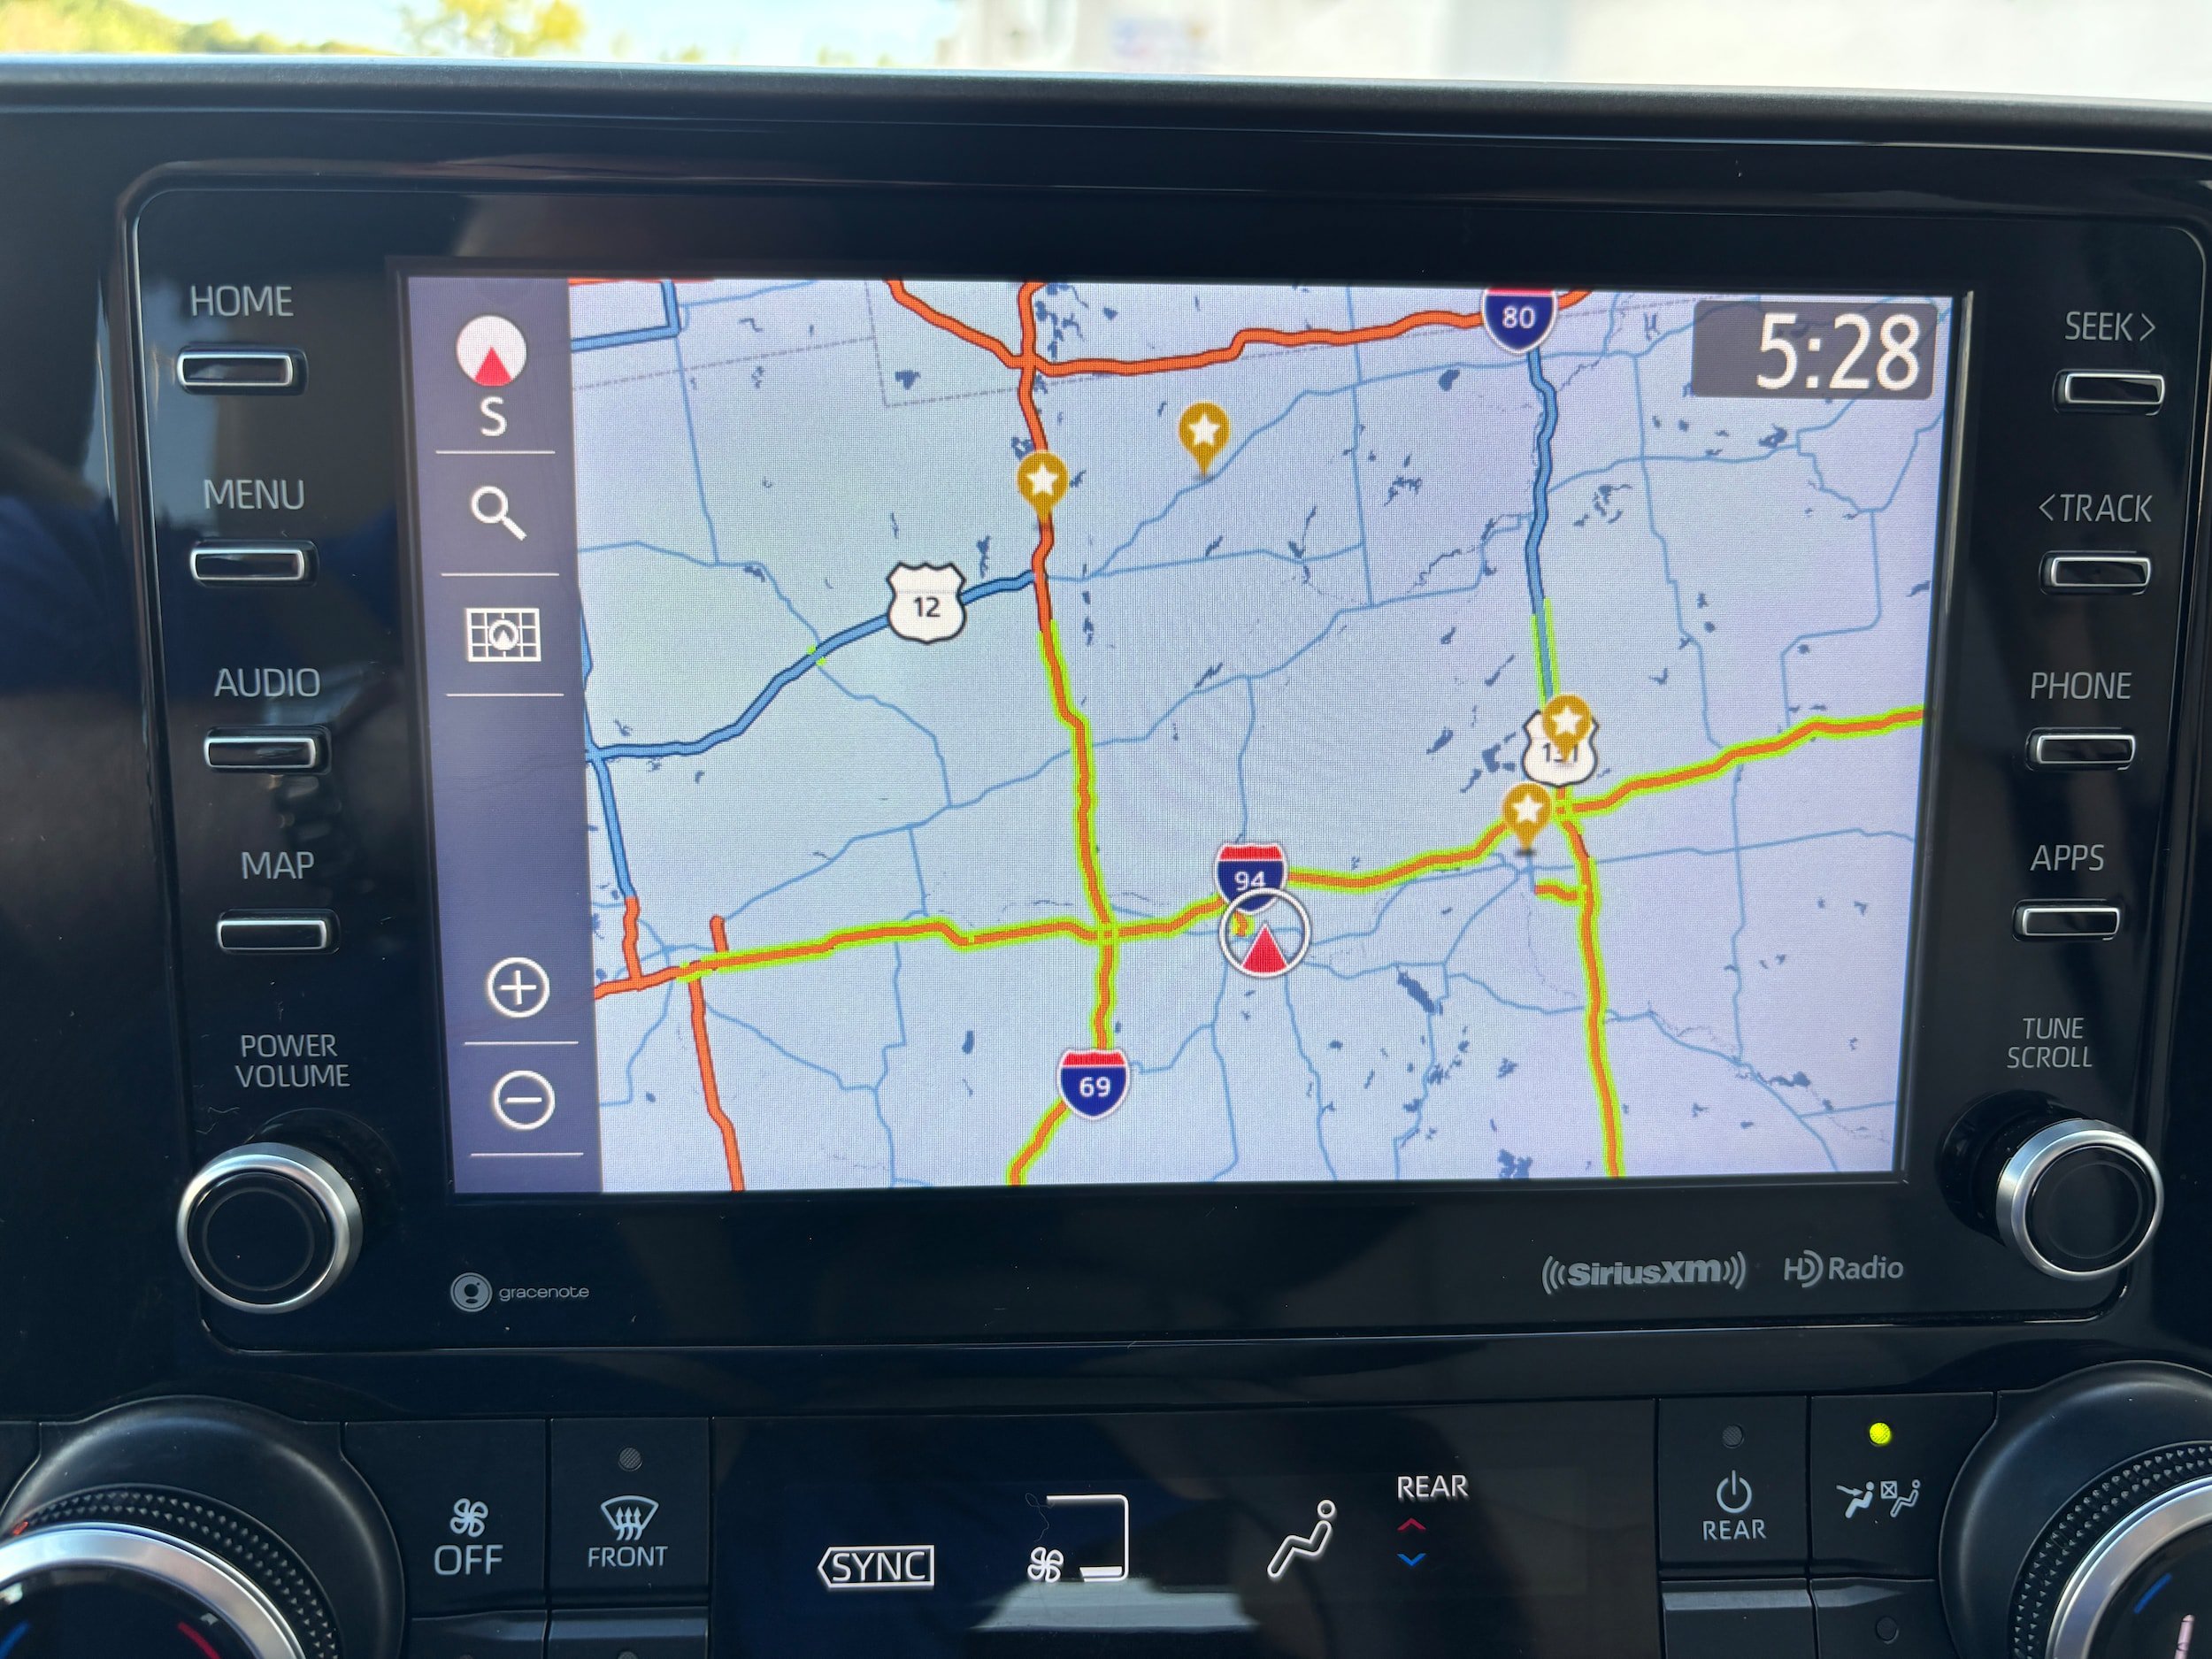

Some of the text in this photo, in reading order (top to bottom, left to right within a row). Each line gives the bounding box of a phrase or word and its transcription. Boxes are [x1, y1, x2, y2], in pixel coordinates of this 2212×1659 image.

[190, 285, 294, 317] HOME
[1502, 307, 1535, 329] 80
[1755, 312, 1922, 391] 5:28
[480, 396, 507, 436] S
[204, 479, 304, 511] MENU
[914, 596, 940, 619] 12
[213, 667, 321, 698] AUDIO
[2030, 672, 2132, 700] PHONE
[241, 851, 315, 879] MAP
[2030, 844, 2105, 872] APPS
[1233, 871, 1266, 892] 94
[2023, 1017, 2085, 1040] TUNE
[241, 1033, 339, 1057] POWER
[2007, 1046, 2093, 1069] SCROLL
[234, 1064, 350, 1088] VOLUME
[1079, 1076, 1111, 1098] 69
[1784, 1249, 1904, 1288] HD Radio
[498, 1286, 590, 1302] gracenote
[1397, 1474, 1470, 1500] REAR
[1702, 1519, 1767, 1540] REAR
[434, 1544, 503, 1576] OFF
[588, 1546, 669, 1568] FRONT
[832, 1550, 926, 1584] SYNC
